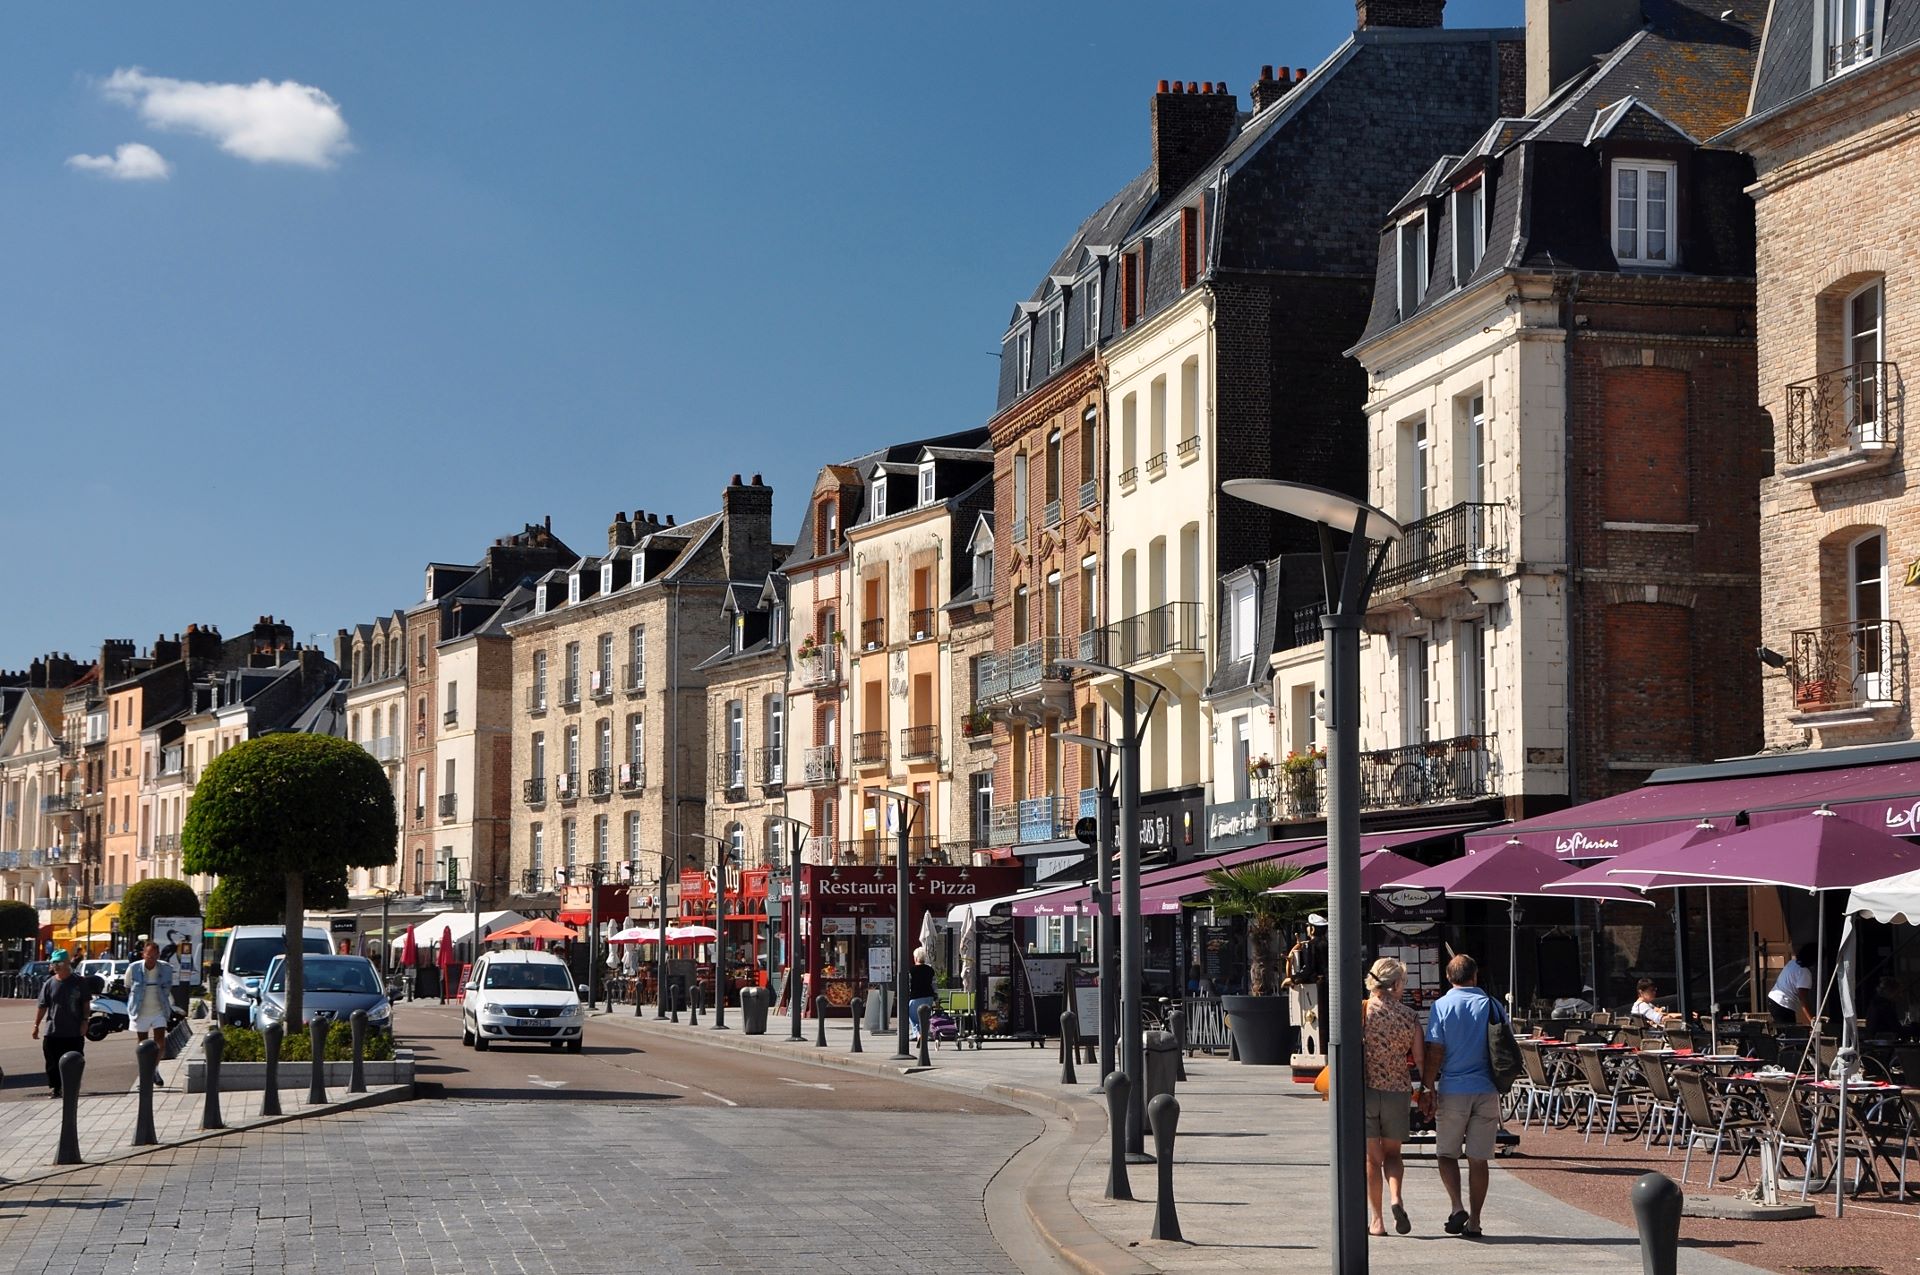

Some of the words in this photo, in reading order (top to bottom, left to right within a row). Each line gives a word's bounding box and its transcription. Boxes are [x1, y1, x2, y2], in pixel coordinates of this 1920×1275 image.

[1555, 836, 1568, 850] La
[1573, 832, 1619, 852] Marine
[708, 865, 740, 894] Slly
[819, 879, 916, 895] Restaurat
[930, 879, 976, 895] Pizza
[1404, 892, 1428, 901] Marine
